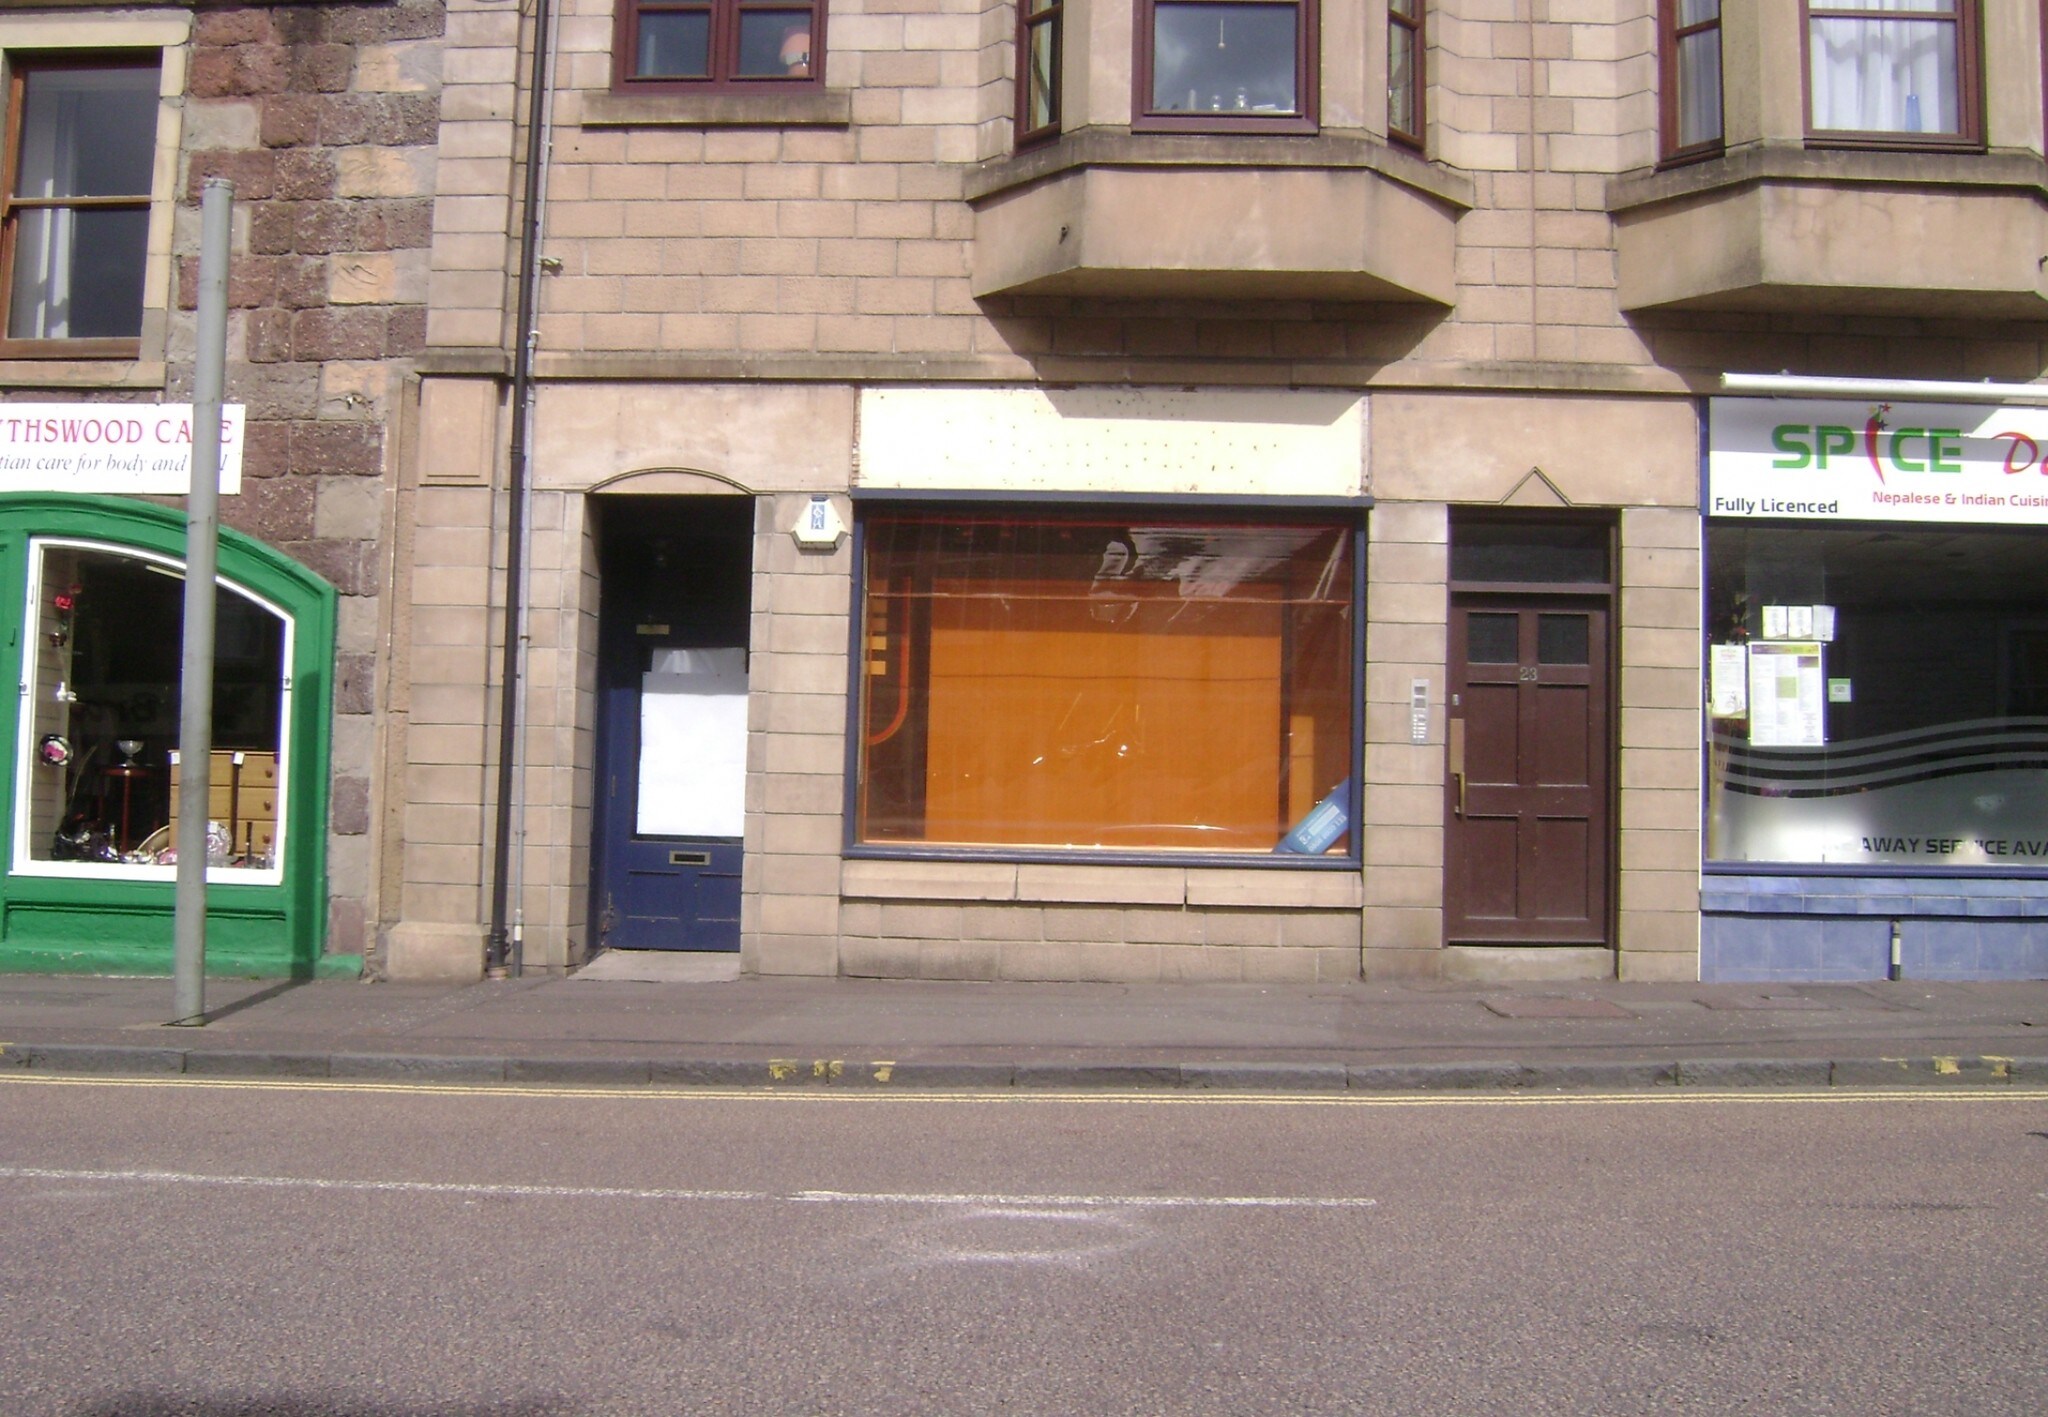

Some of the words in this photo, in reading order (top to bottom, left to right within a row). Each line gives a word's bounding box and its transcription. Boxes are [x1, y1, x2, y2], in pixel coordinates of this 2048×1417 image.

[0, 419, 143, 444] THSWOOD
[156, 419, 233, 444] CAE
[1771, 415, 1962, 485] SPICE
[36, 457, 72, 470] care
[73, 453, 101, 476] for
[106, 453, 147, 476] body
[152, 454, 187, 471] and
[1715, 497, 1755, 515] Fully
[1761, 498, 1838, 513] Licenced
[1873, 491, 1940, 506] Nepalese
[1945, 493, 1957, 504] &
[1962, 493, 2005, 505] Indian
[1519, 667, 1538, 681] 23
[1862, 837, 1918, 853] AWAY
[1926, 838, 2007, 856] SERICE
